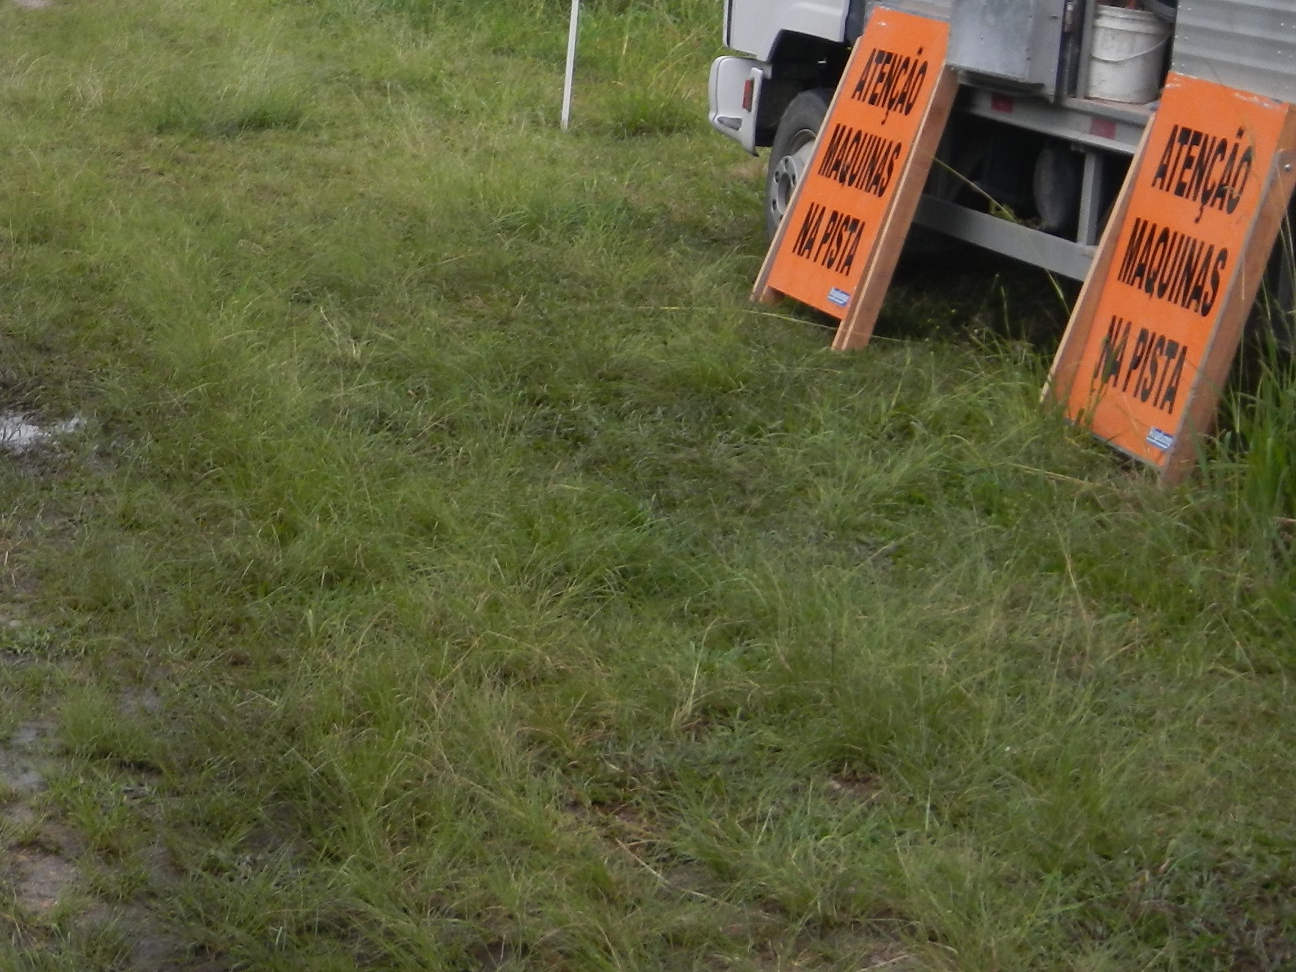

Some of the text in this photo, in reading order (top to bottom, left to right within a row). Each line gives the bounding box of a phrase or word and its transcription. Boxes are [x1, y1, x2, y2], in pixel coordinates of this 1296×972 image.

[851, 46, 929, 125] ATENÇÃO
[817, 123, 902, 198] MAQUINAS
[1152, 125, 1253, 224] ATENÇÃO
[792, 202, 866, 276] NA PISTA
[1117, 217, 1228, 318] MAQUINAS
[1094, 315, 1188, 415] NA PISTA
